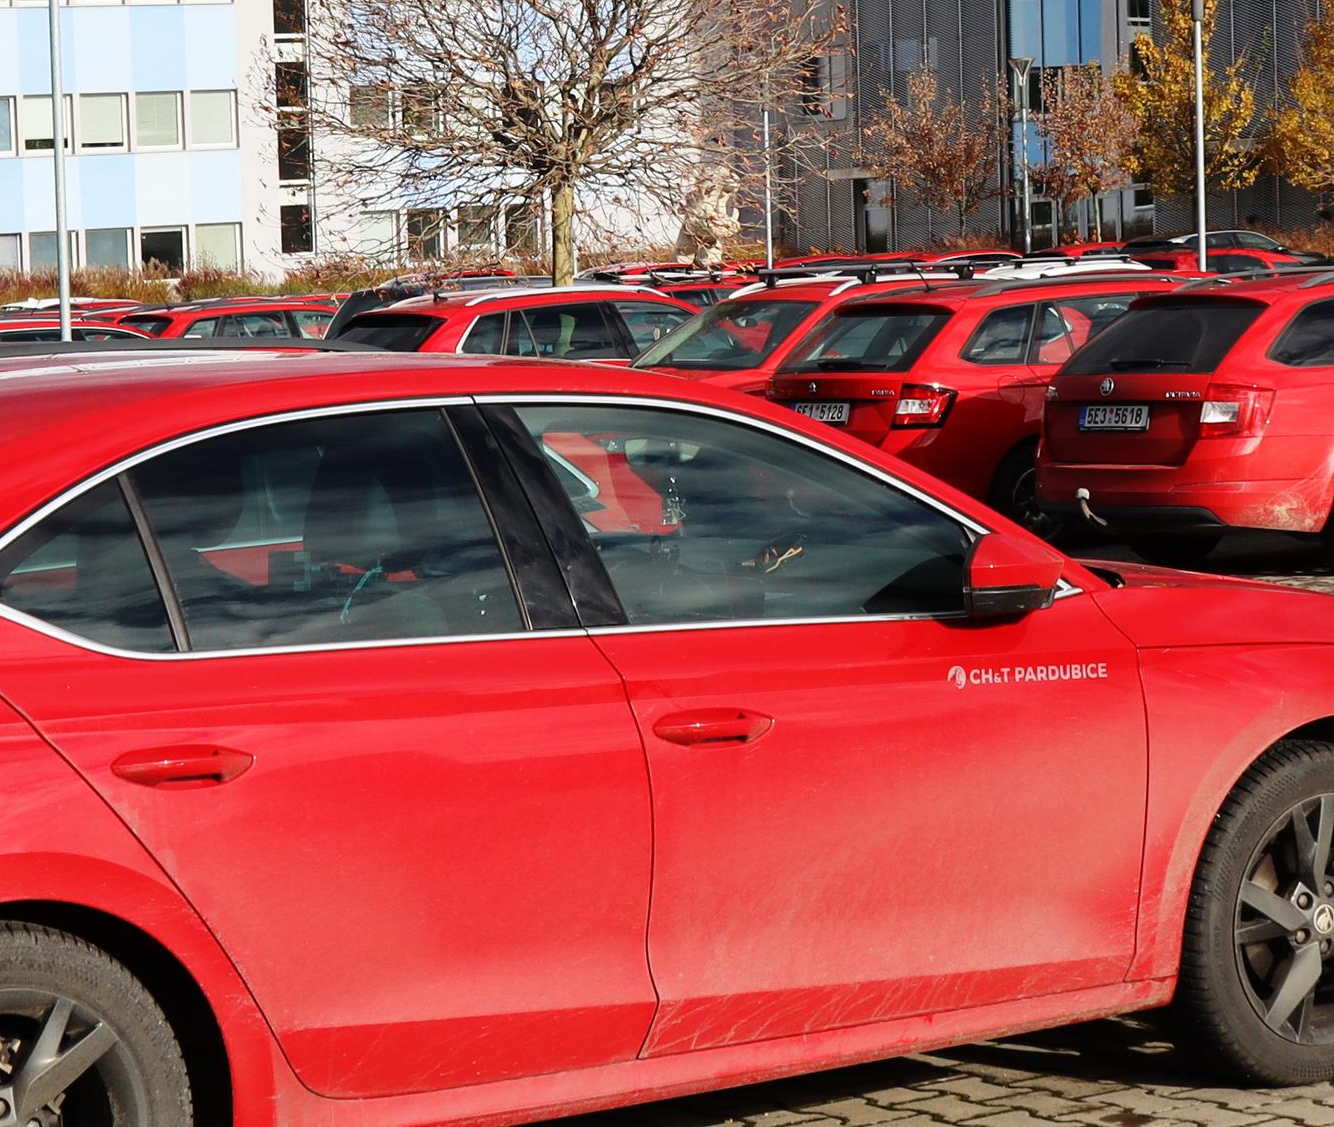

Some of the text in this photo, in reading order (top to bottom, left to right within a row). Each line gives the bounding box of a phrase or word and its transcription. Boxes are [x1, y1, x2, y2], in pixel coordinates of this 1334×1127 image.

[819, 405, 844, 420] 5128
[1087, 408, 1143, 424] 5E3 5618
[969, 663, 1108, 685] CH&T PARDUBICE
